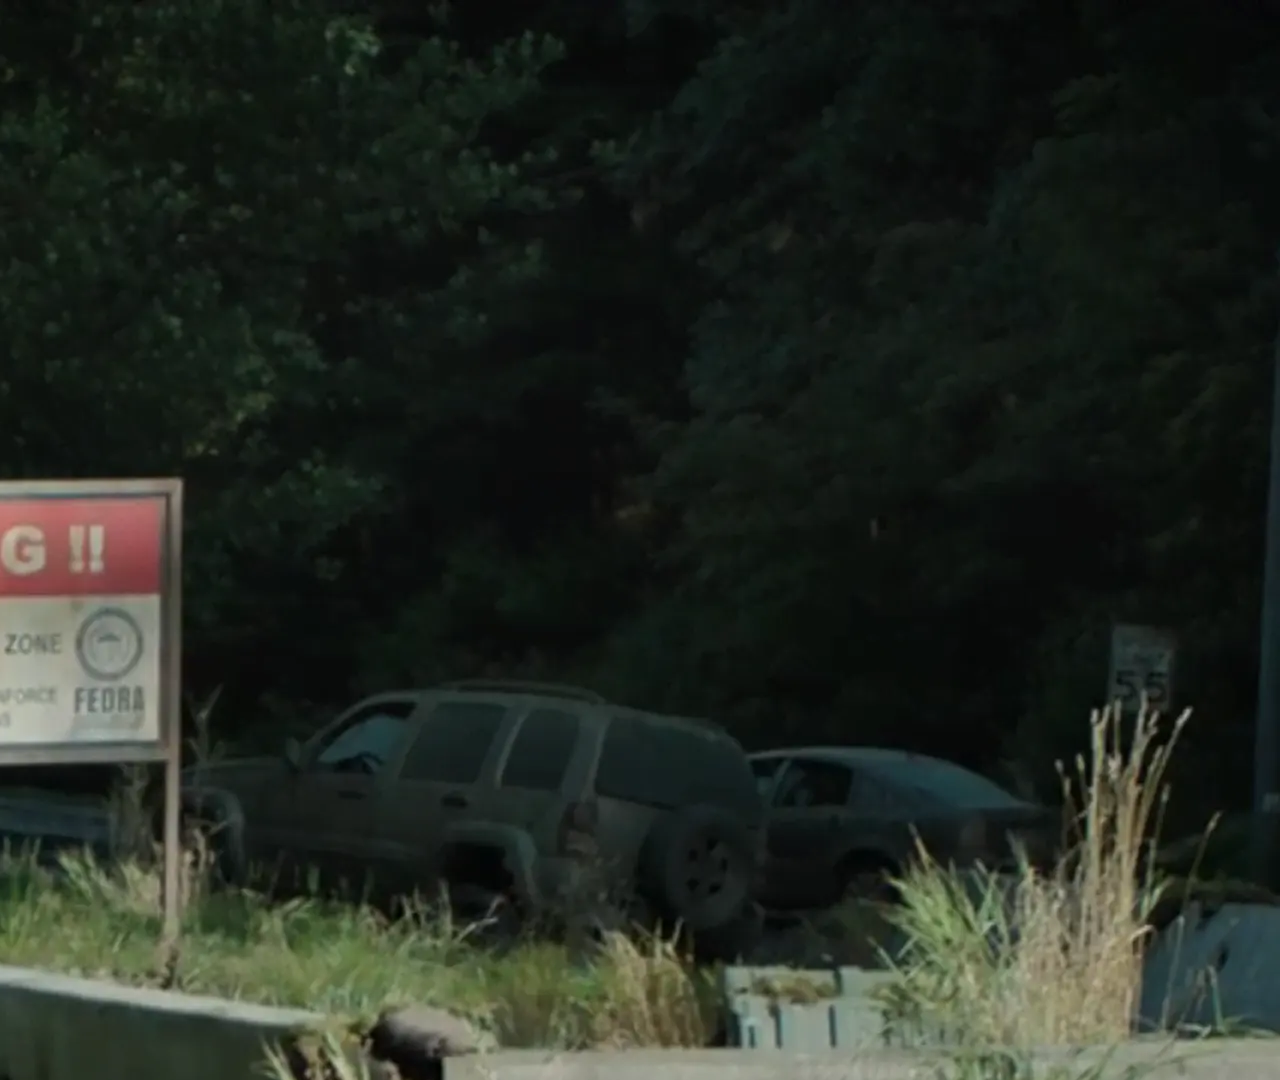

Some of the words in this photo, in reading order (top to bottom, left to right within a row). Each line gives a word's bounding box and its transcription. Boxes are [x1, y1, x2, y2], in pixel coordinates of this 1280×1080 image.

[69, 525, 105, 574] !!
[4, 633, 62, 656] ZONE
[74, 686, 144, 714] FEDRA
[1111, 669, 1167, 703] 55
